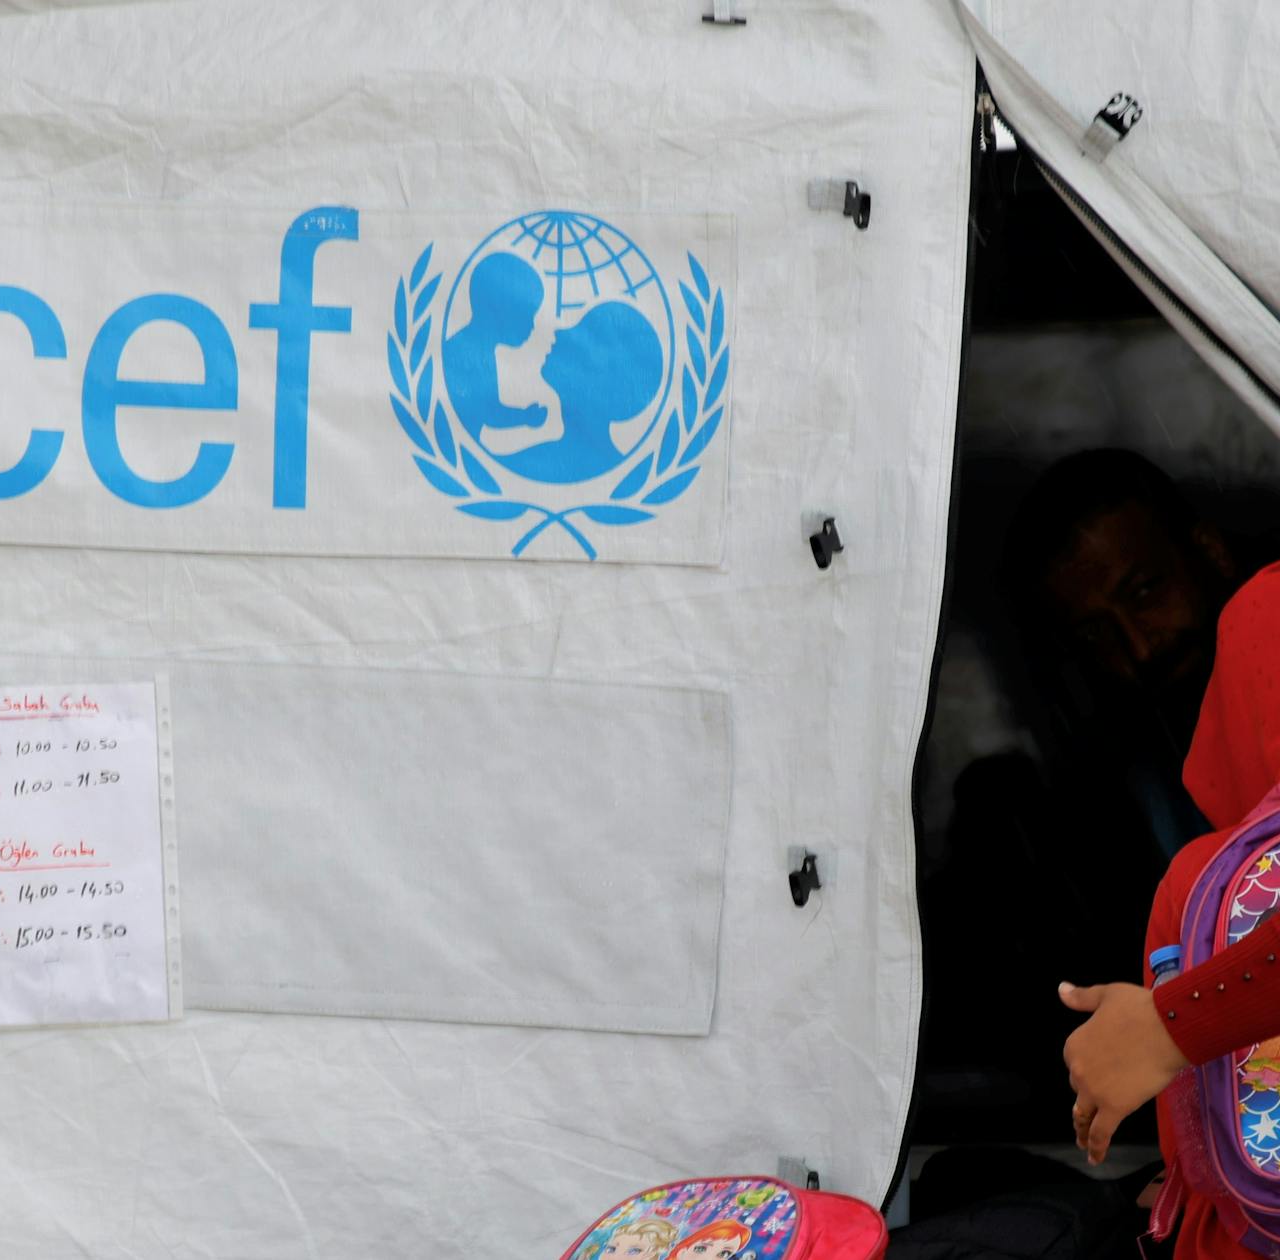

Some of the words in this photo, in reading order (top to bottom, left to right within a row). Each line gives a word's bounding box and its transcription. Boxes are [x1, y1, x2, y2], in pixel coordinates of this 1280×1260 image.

[16, 741, 51, 757] 10.00
[76, 738, 118, 752] 10.50
[14, 779, 53, 796] 11.00
[77, 770, 120, 788] 11.50
[19, 884, 58, 904] 14.00
[81, 881, 124, 900] 14.50
[16, 926, 54, 949] 15.00
[77, 922, 127, 941] 15.50
